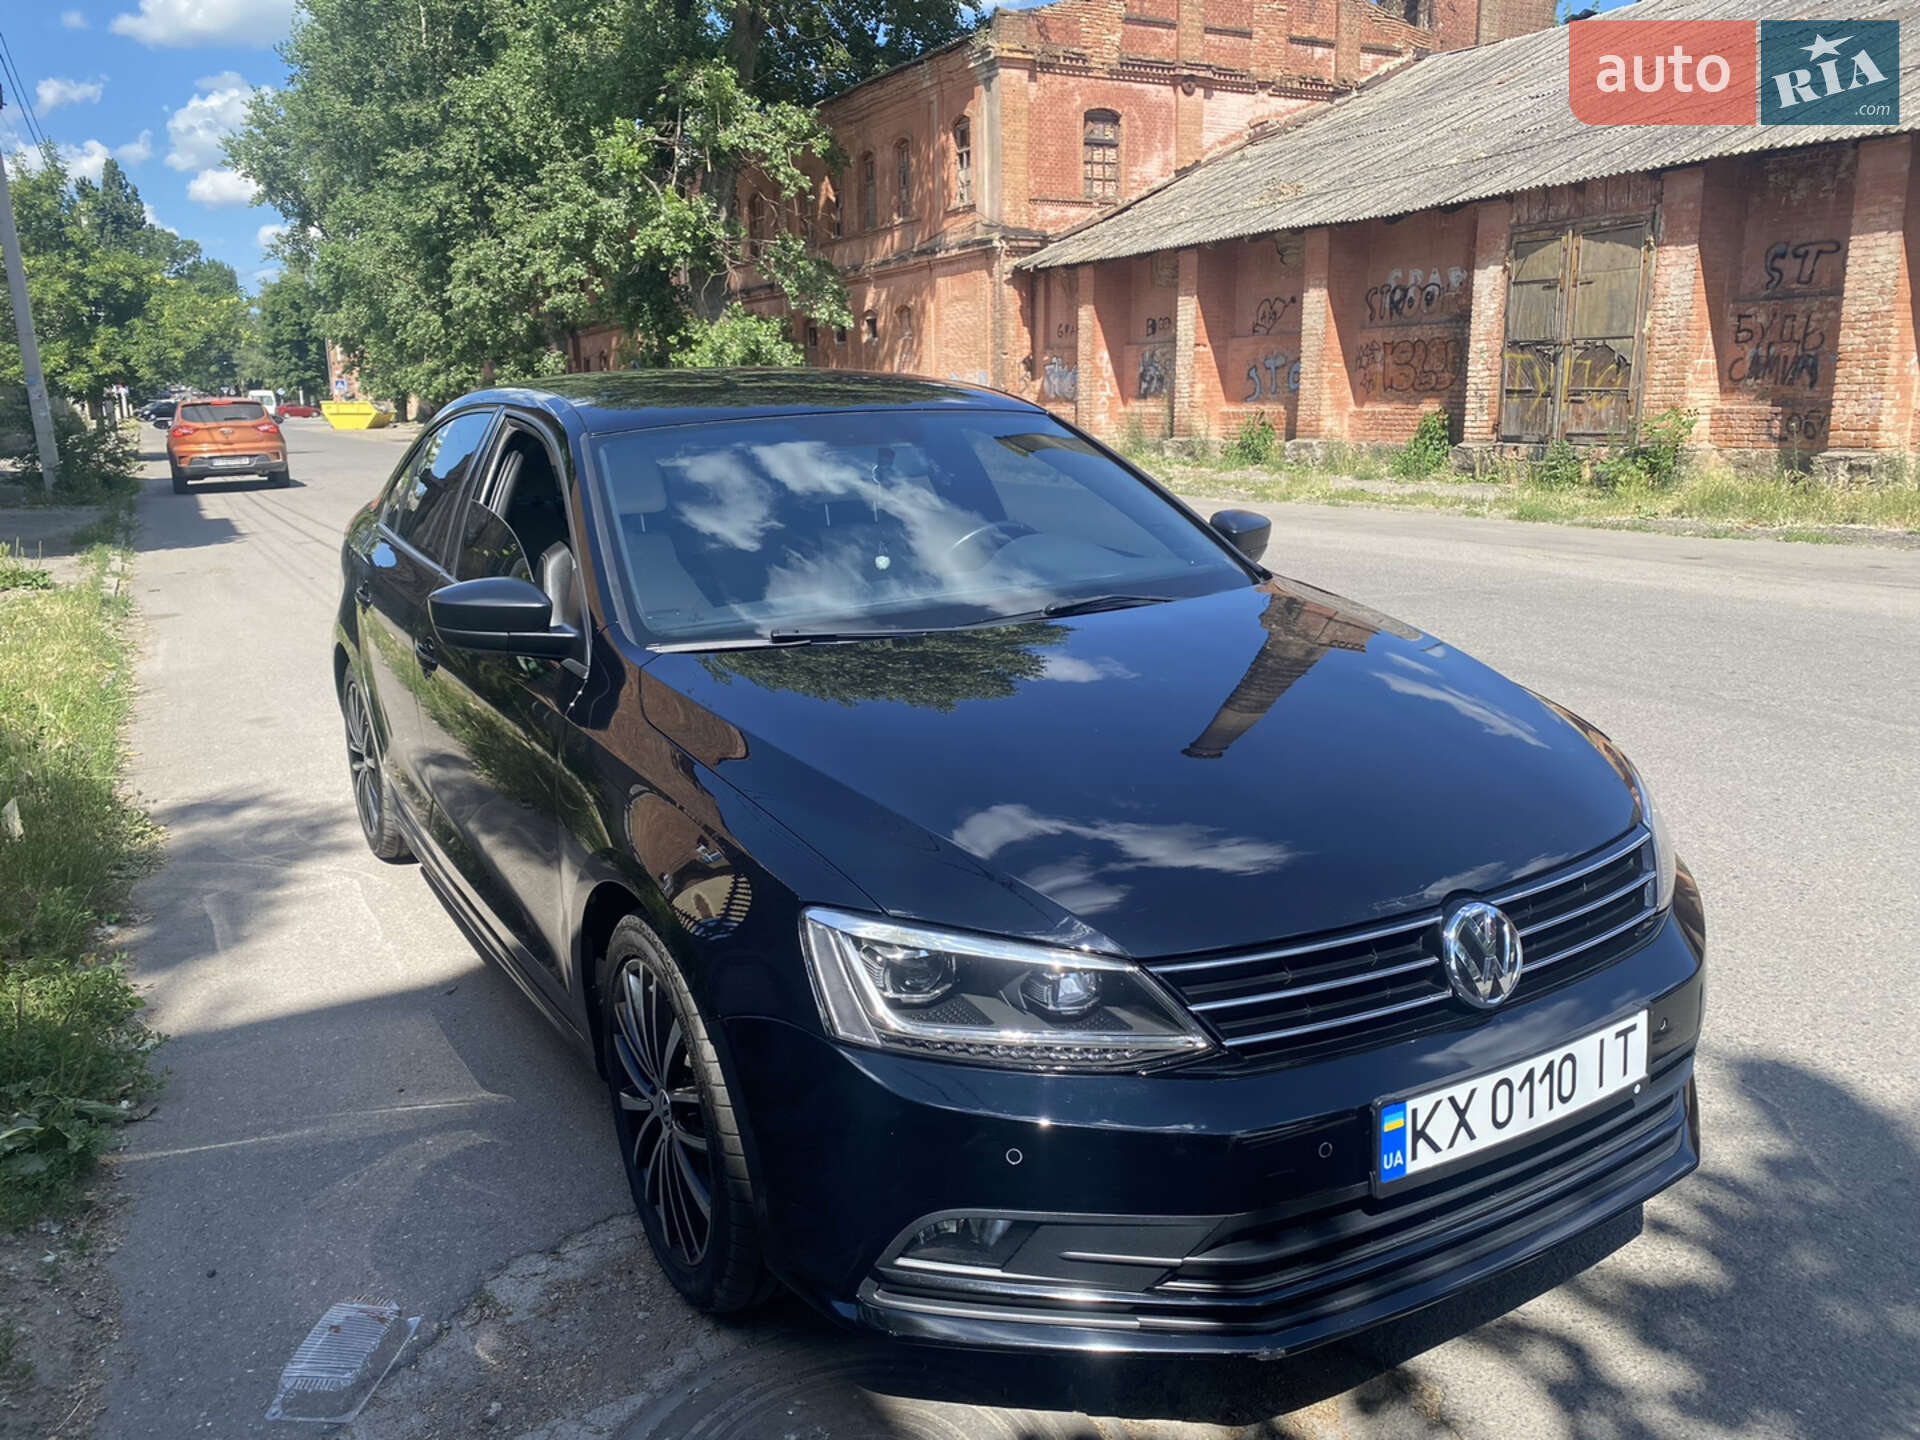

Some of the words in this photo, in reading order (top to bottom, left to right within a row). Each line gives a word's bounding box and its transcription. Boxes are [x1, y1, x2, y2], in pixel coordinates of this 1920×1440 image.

[1411, 1087, 1478, 1162] KX
[1491, 1052, 1577, 1130] 0110
[1599, 1023, 1637, 1089] IT
[1383, 1149, 1404, 1169] UA
